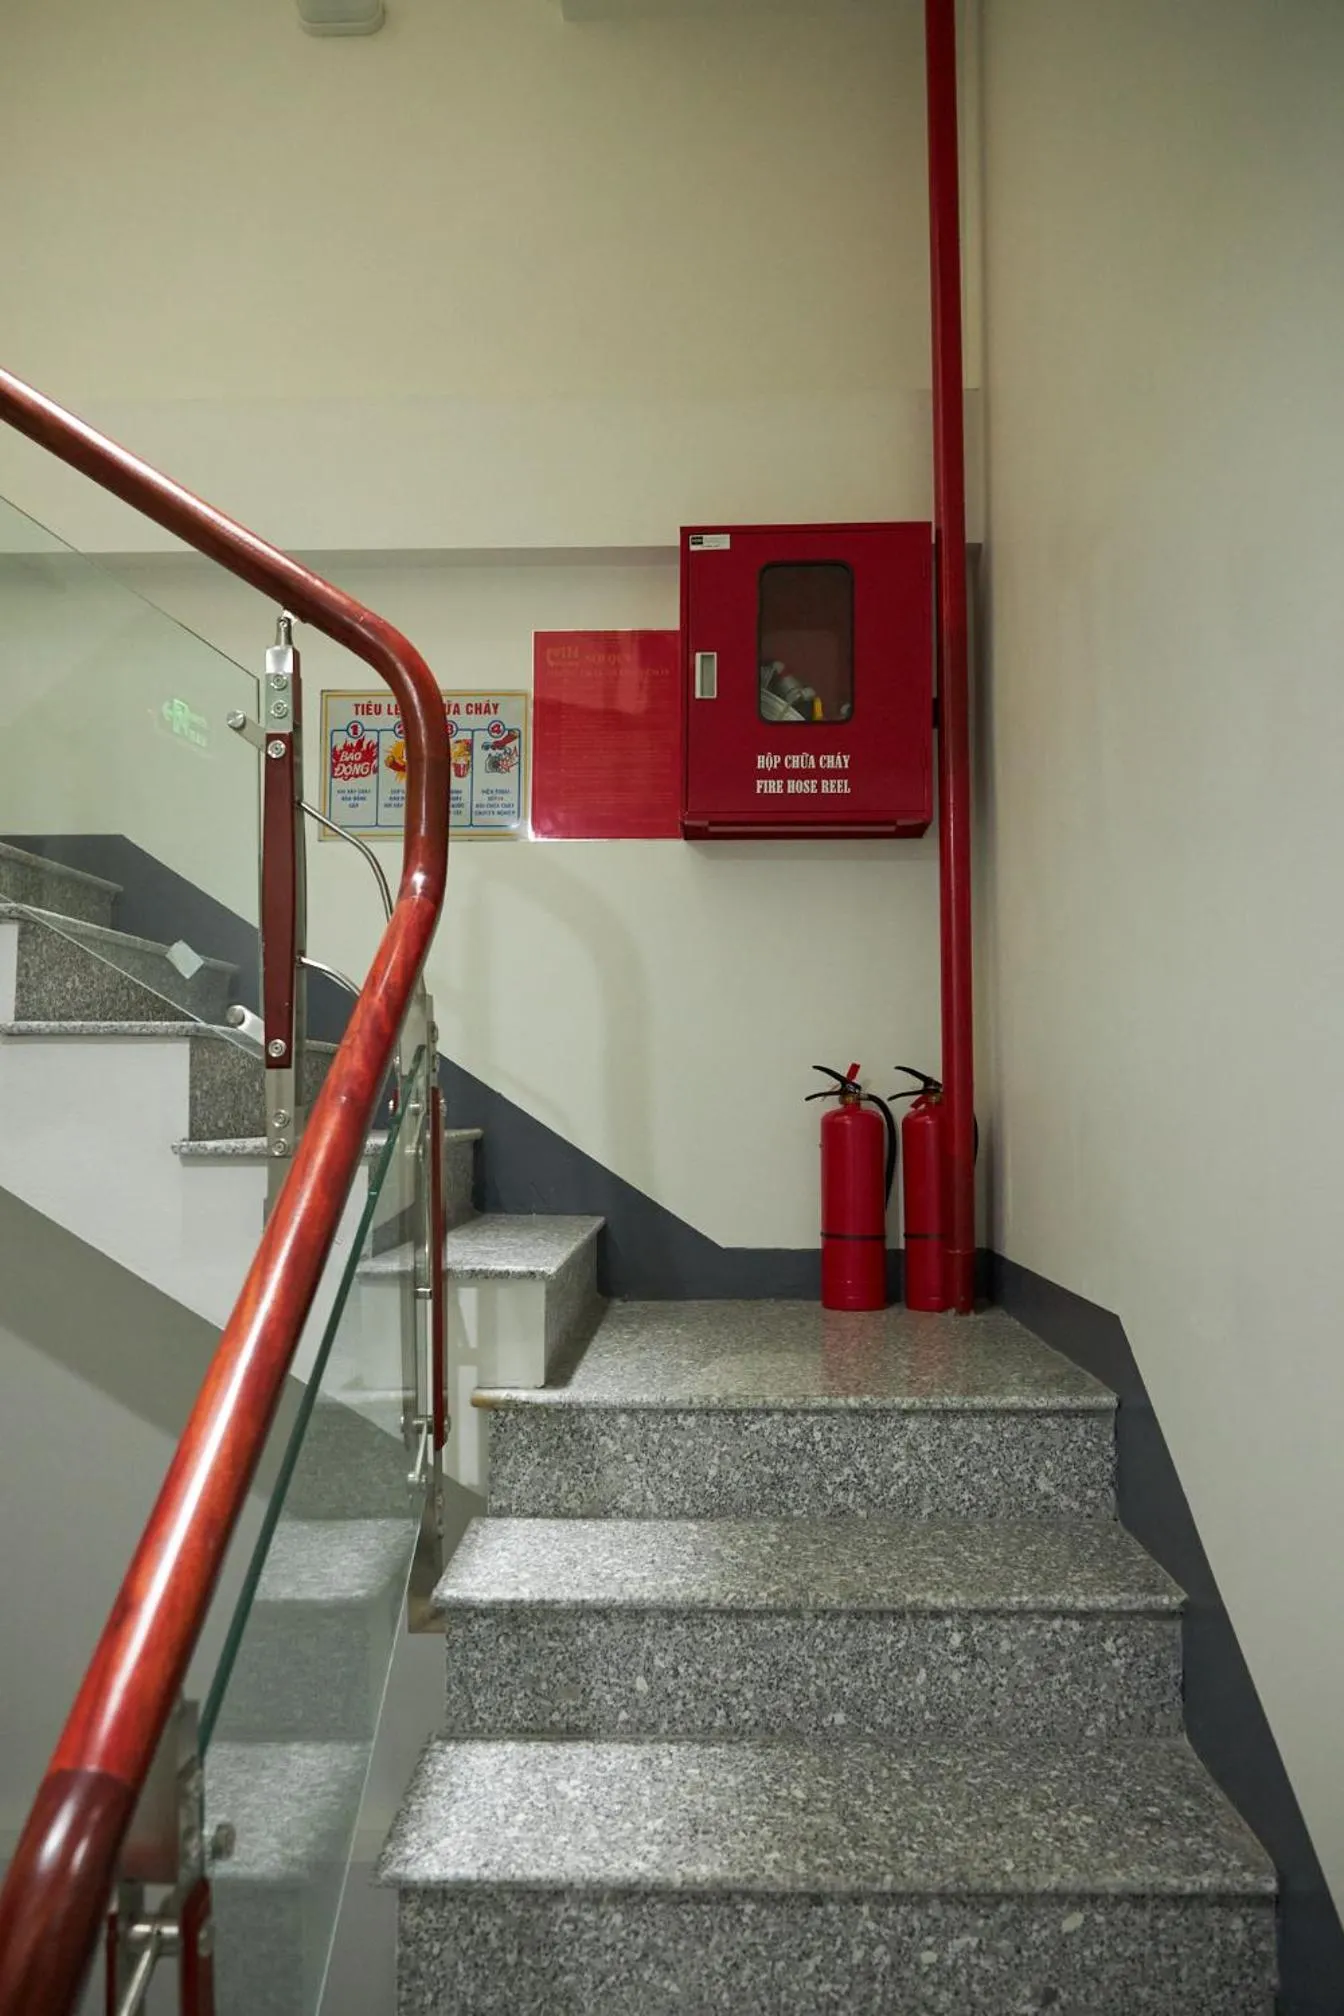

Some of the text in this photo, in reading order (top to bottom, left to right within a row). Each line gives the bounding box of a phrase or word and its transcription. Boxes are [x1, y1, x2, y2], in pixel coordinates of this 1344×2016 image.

[354, 699, 382, 716] TIÊU
[465, 699, 499, 716] CHÁY
[491, 723, 501, 735] 4
[757, 752, 851, 771] HỘP CHỮA CHÁY
[756, 779, 851, 794] FIRE HOSE REEL
